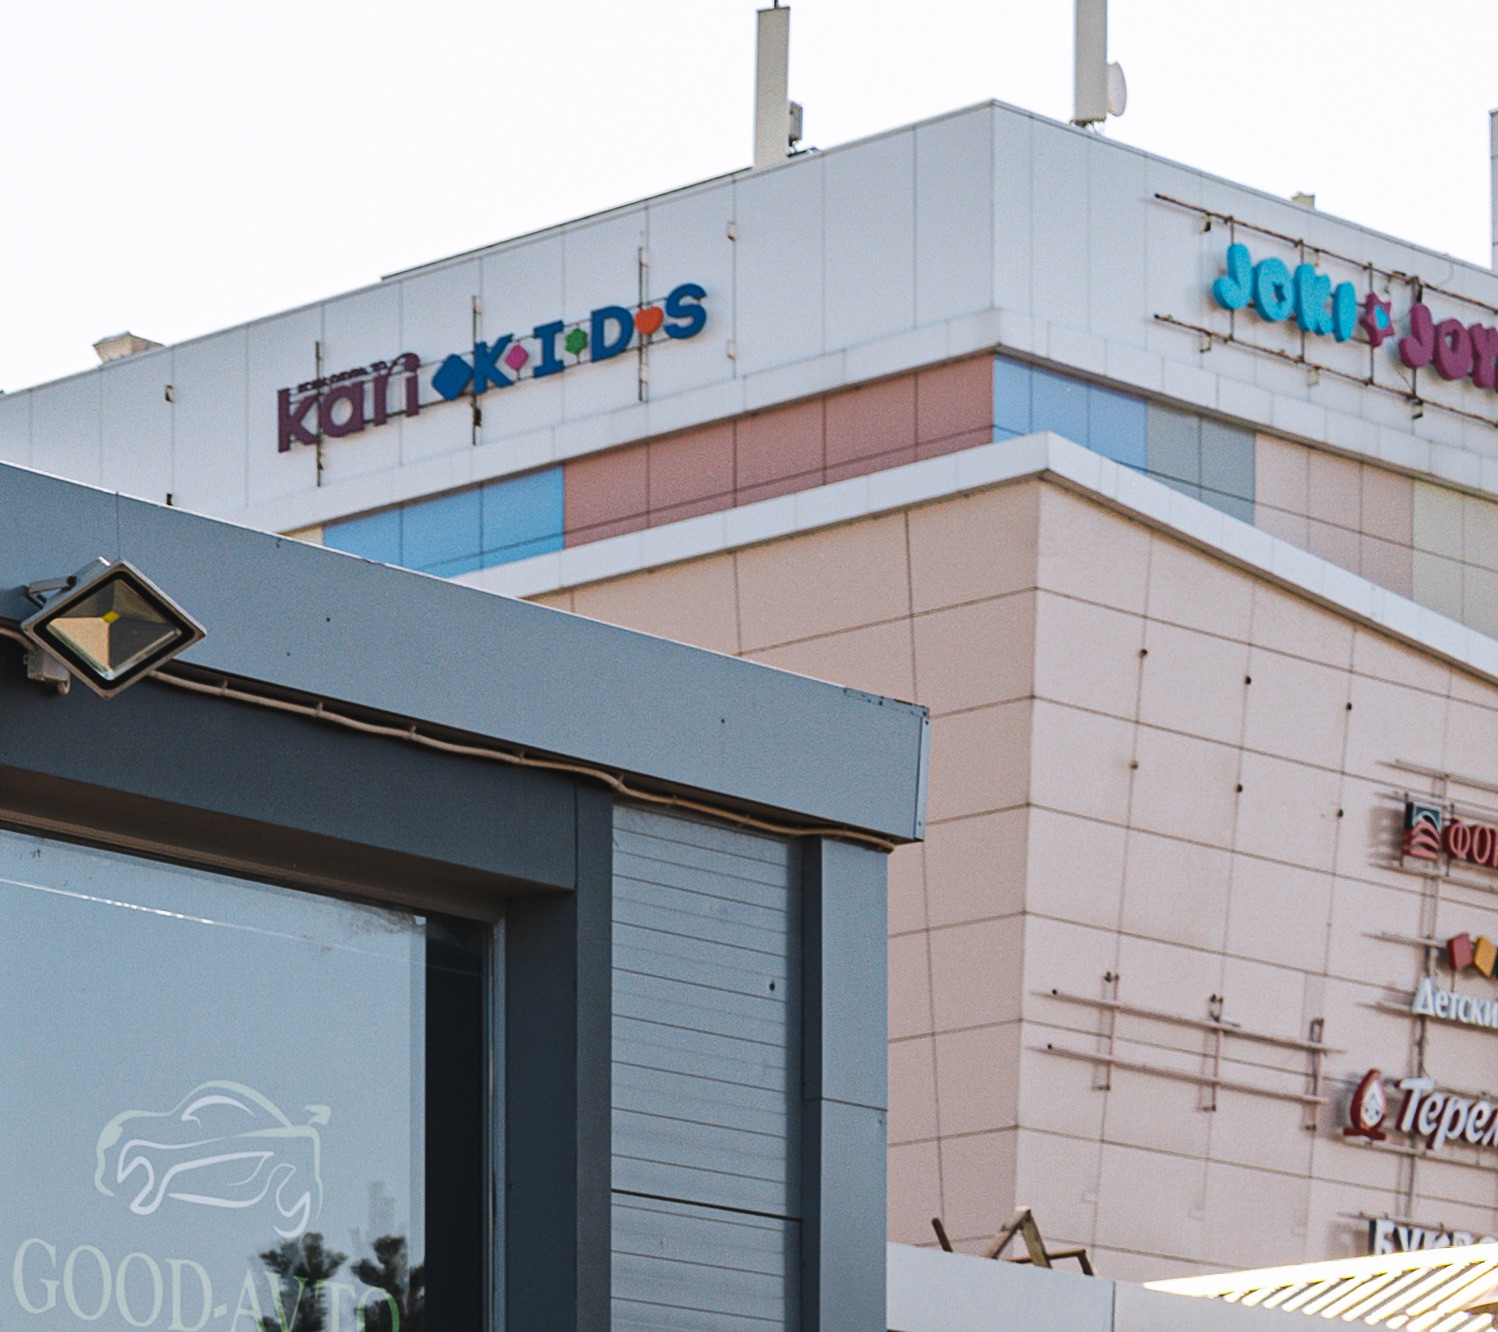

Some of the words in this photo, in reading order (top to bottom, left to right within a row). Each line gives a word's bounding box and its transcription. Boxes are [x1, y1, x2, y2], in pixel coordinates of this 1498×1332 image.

[278, 352, 421, 453] kari
[473, 283, 708, 395] KIDS
[1449, 819, 1498, 867] ФО
